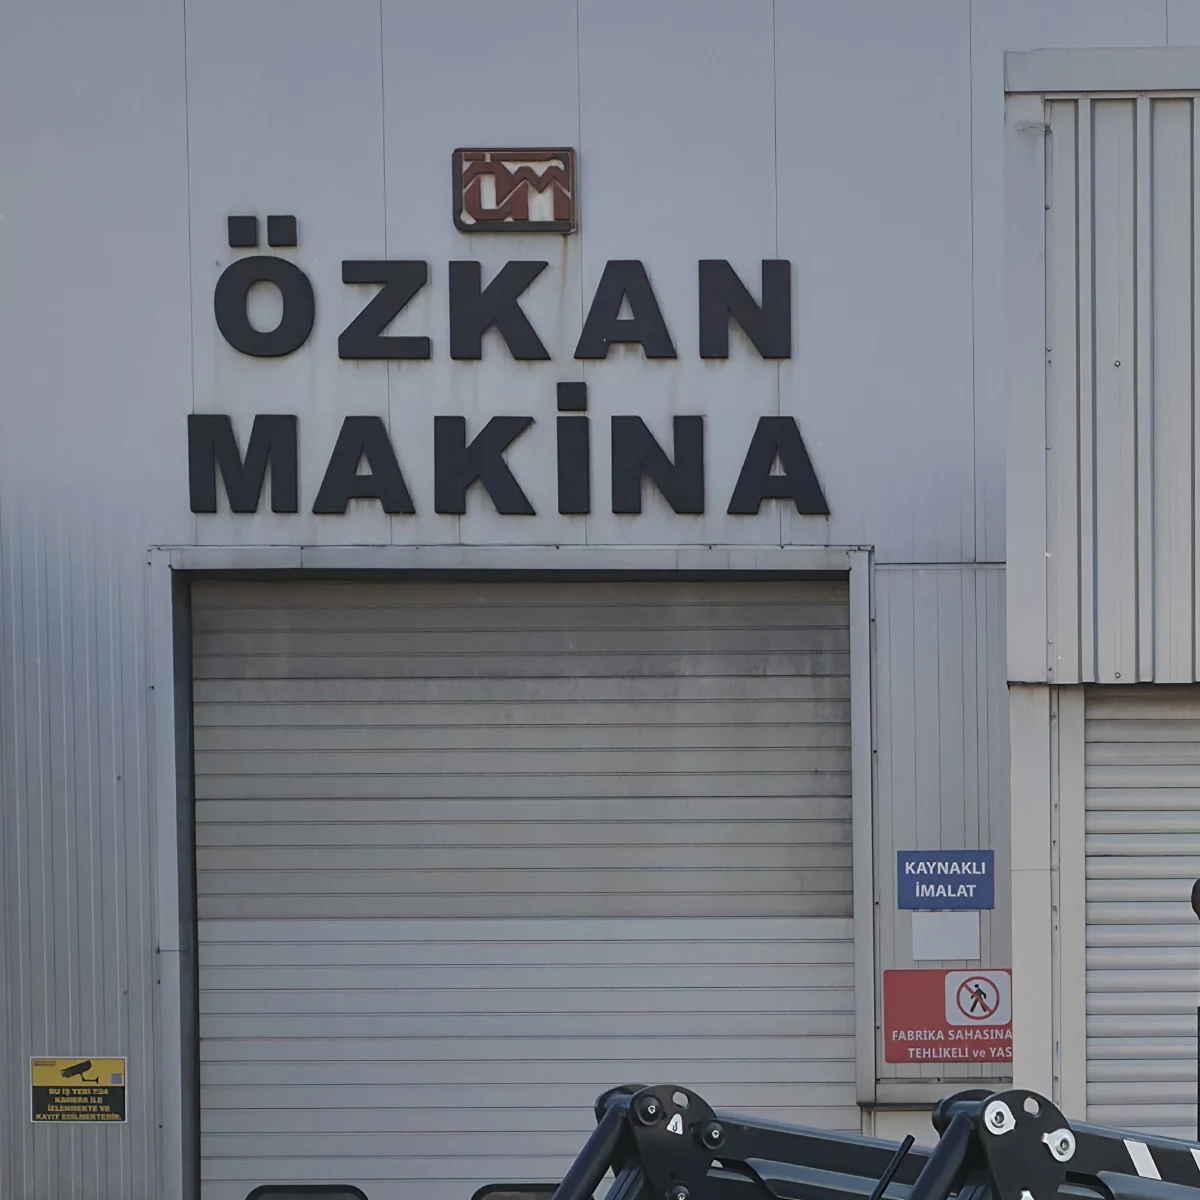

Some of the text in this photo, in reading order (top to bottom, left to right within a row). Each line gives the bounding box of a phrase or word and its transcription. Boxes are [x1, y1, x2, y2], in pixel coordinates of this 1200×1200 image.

[214, 215, 792, 359] ÖZKAN
[187, 381, 830, 514] MAKİNA
[905, 861, 985, 875] KAYNAKLI
[915, 881, 976, 898] İMALAT
[892, 1028, 1012, 1041] FABRİKA SAHASINA
[908, 1046, 969, 1059] TEHLİKELİ
[972, 1050, 986, 1058] ve
